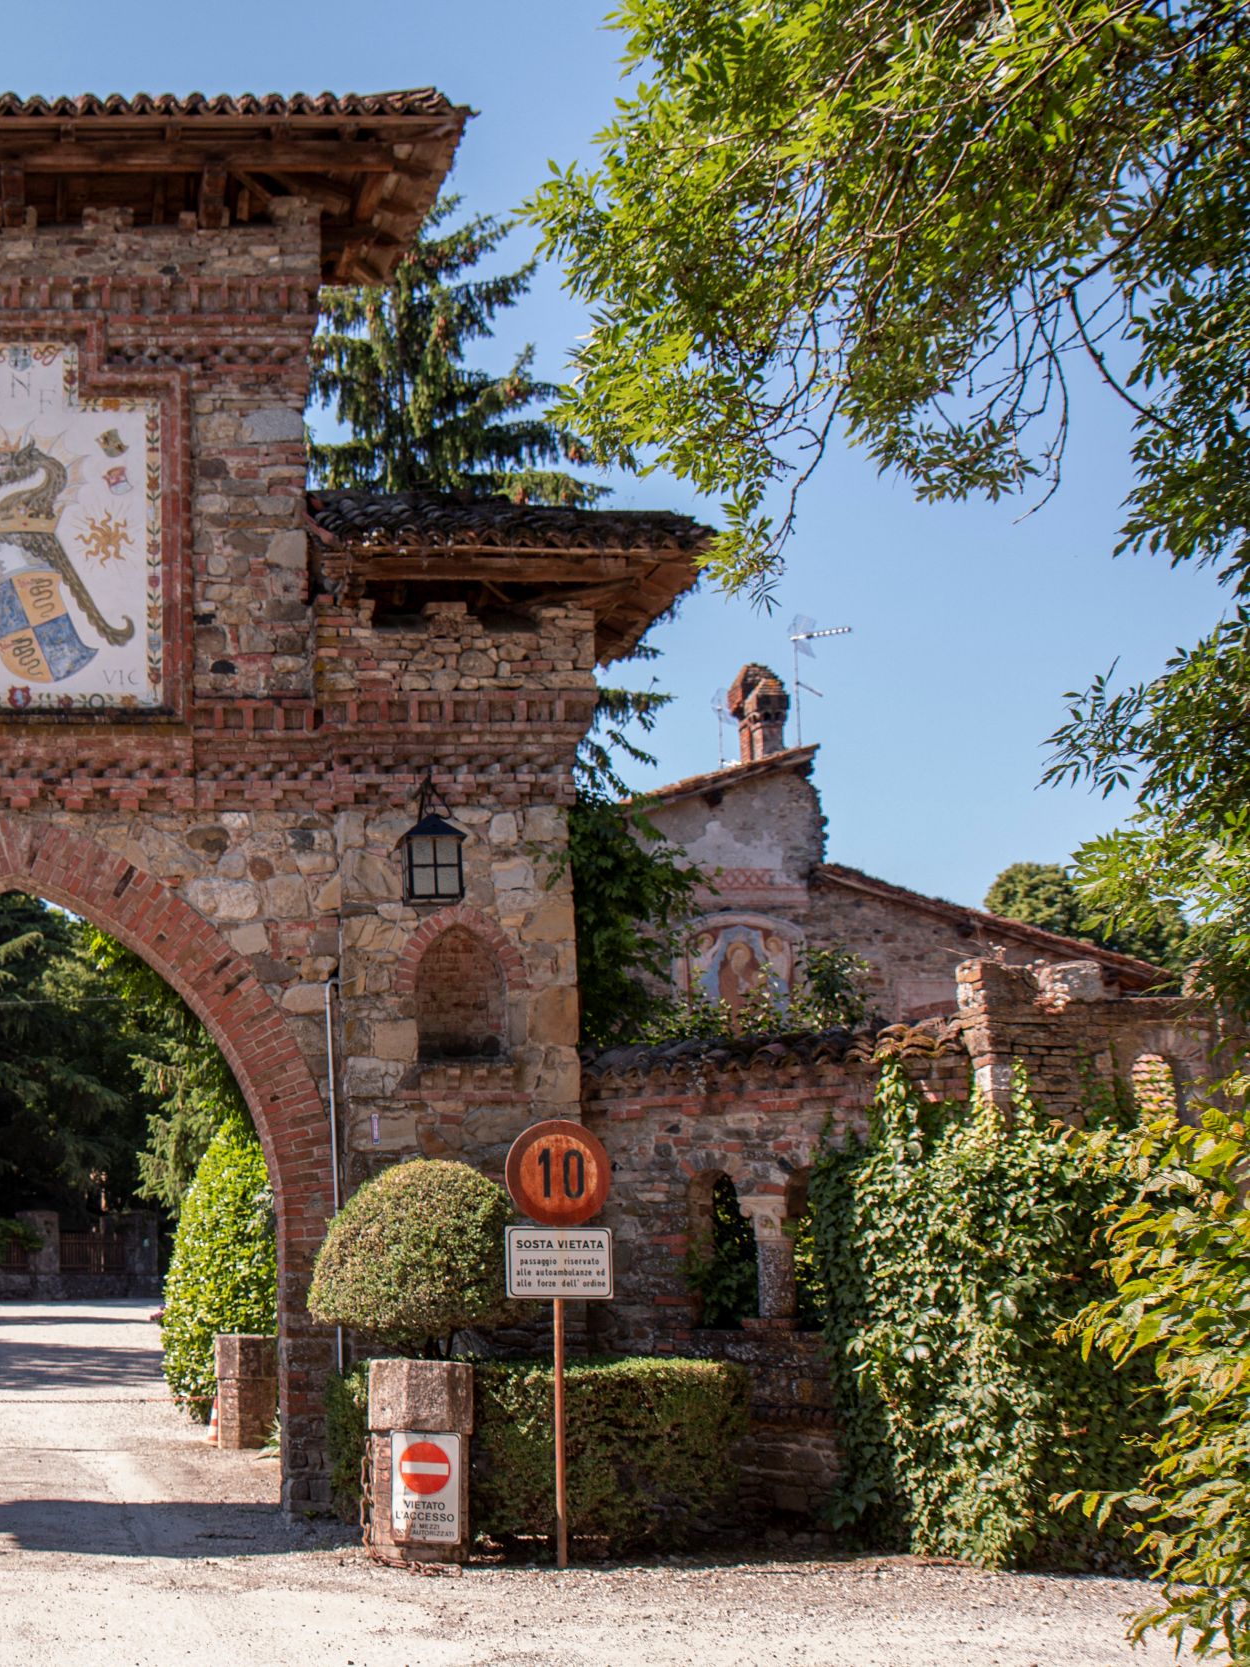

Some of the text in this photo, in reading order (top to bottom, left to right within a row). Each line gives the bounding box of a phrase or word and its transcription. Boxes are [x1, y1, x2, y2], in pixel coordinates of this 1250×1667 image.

[11, 373, 31, 398] N
[538, 1148, 584, 1198] 10
[516, 1240, 604, 1248] SOSTA VIETATA
[520, 1257, 599, 1266] passaggio riservato
[403, 1500, 446, 1511] VIETATO
[395, 1510, 455, 1523] L'ACCESSO
